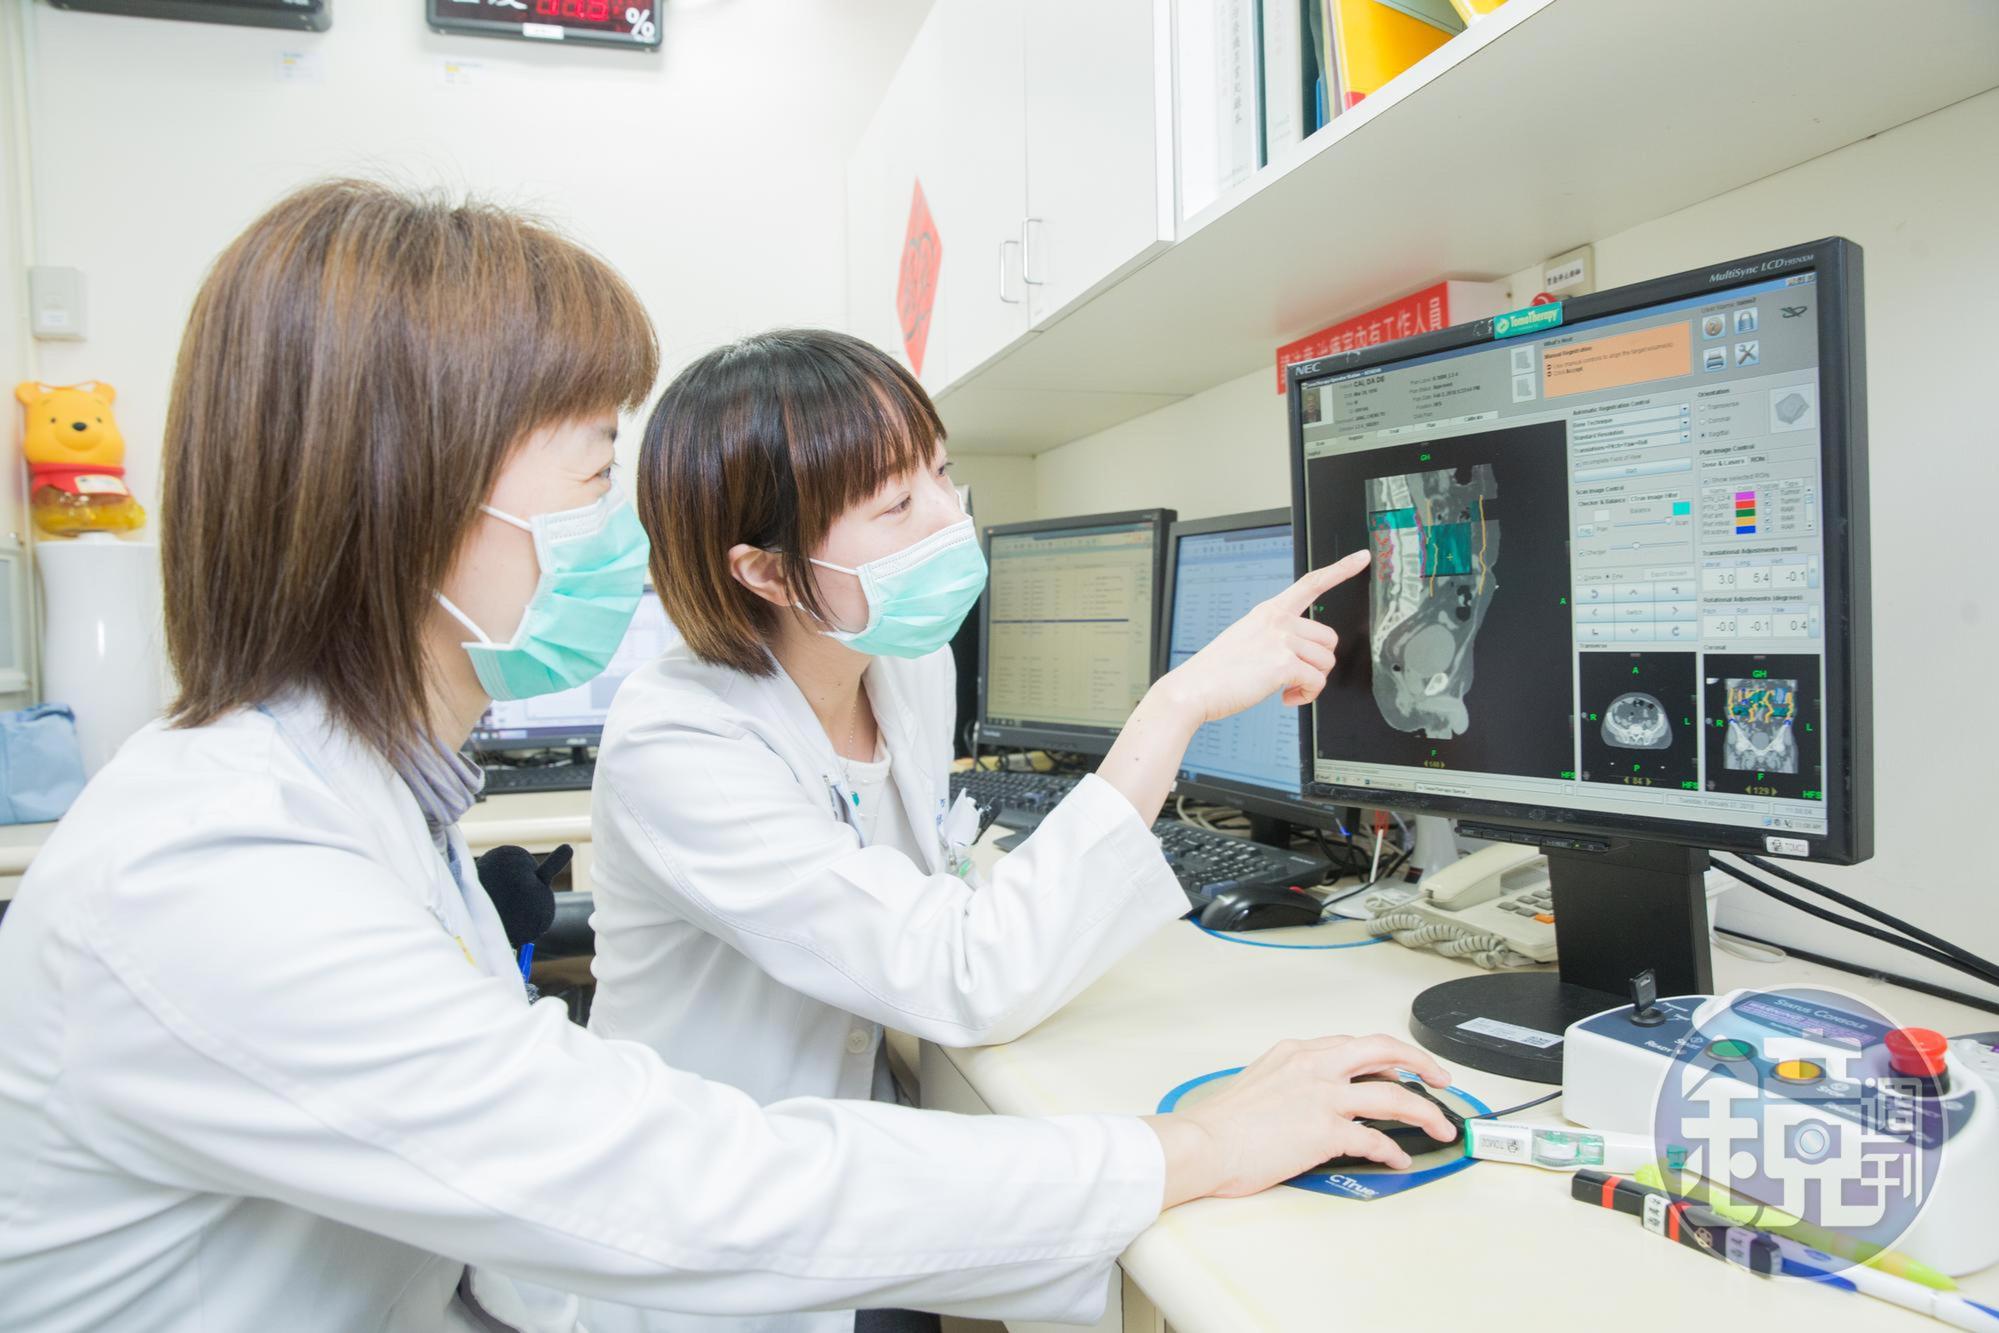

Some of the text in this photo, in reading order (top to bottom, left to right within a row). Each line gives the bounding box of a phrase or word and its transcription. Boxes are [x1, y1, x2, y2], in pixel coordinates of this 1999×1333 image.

[1709, 266, 1758, 283] MultiSync
[1510, 309, 1560, 328] TomoTherapy
[1544, 352, 1562, 360] Manual
[1295, 362, 1321, 376] NEC
[1698, 389, 1730, 397] Orientation
[1573, 407, 1598, 416] Automatic
[1598, 402, 1630, 412] Registration
[1703, 548, 1740, 556] Translational
[1720, 574, 1735, 584] 3.0
[1754, 573, 1769, 583] 5.4
[1786, 570, 1805, 581] -0.1
[1560, 597, 1566, 605] A
[1716, 621, 1736, 631] -0.0
[1750, 621, 1768, 631] -0.1
[1790, 620, 1807, 631] 0.4
[1752, 670, 1766, 678] GH
[1590, 713, 1597, 721] R
[1682, 781, 1698, 789] HFS
[1803, 791, 1822, 799] HFS
[1774, 998, 1869, 1030] STATUS CONSOLE
